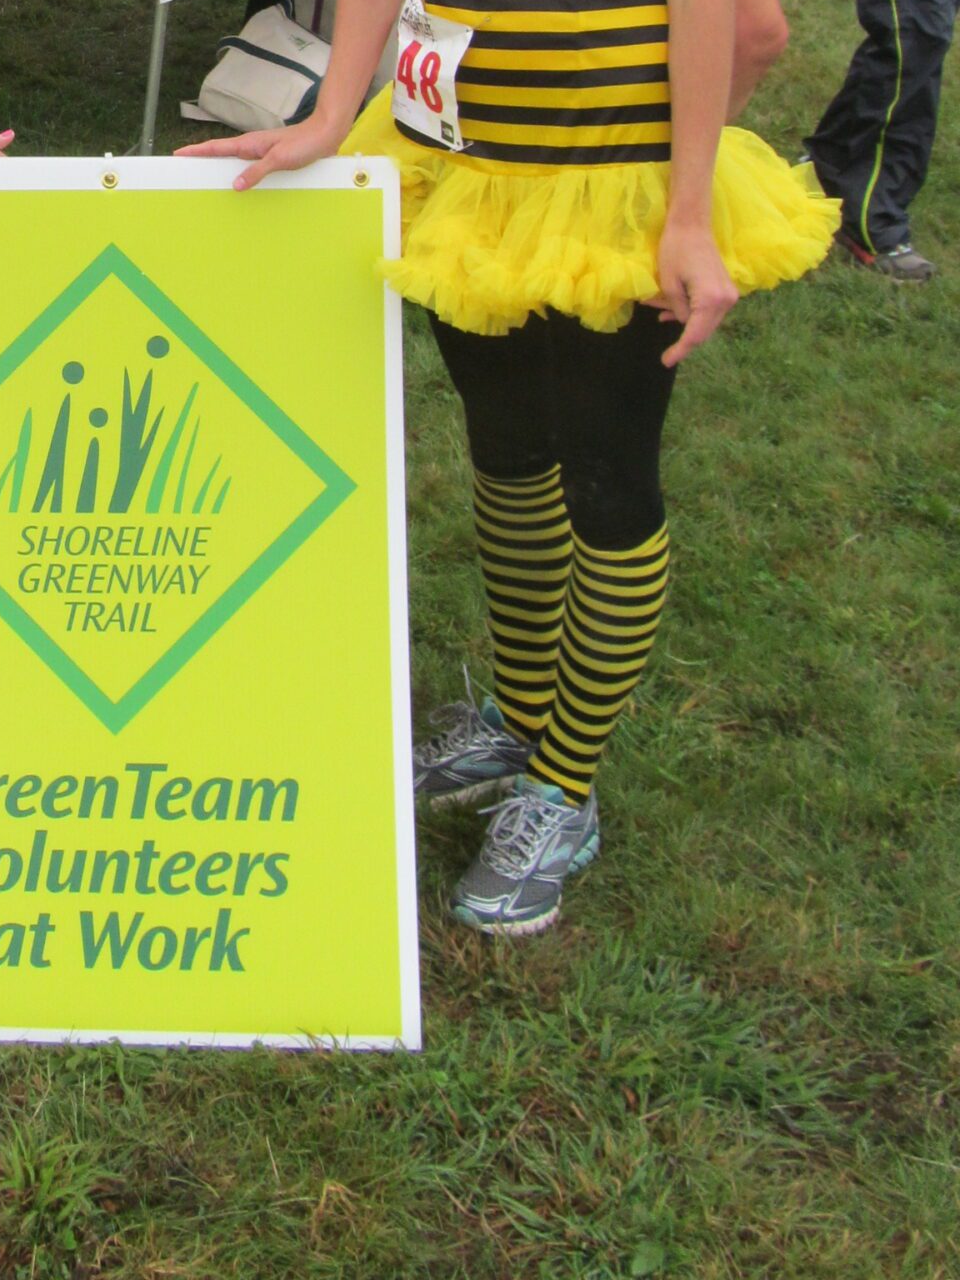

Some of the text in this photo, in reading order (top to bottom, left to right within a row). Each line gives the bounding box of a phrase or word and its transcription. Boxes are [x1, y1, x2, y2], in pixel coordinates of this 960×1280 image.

[17, 525, 212, 556] SHORELINE
[18, 563, 211, 594] GREENWAY
[64, 601, 157, 633] TRAIL
[79, 907, 251, 972] Work
